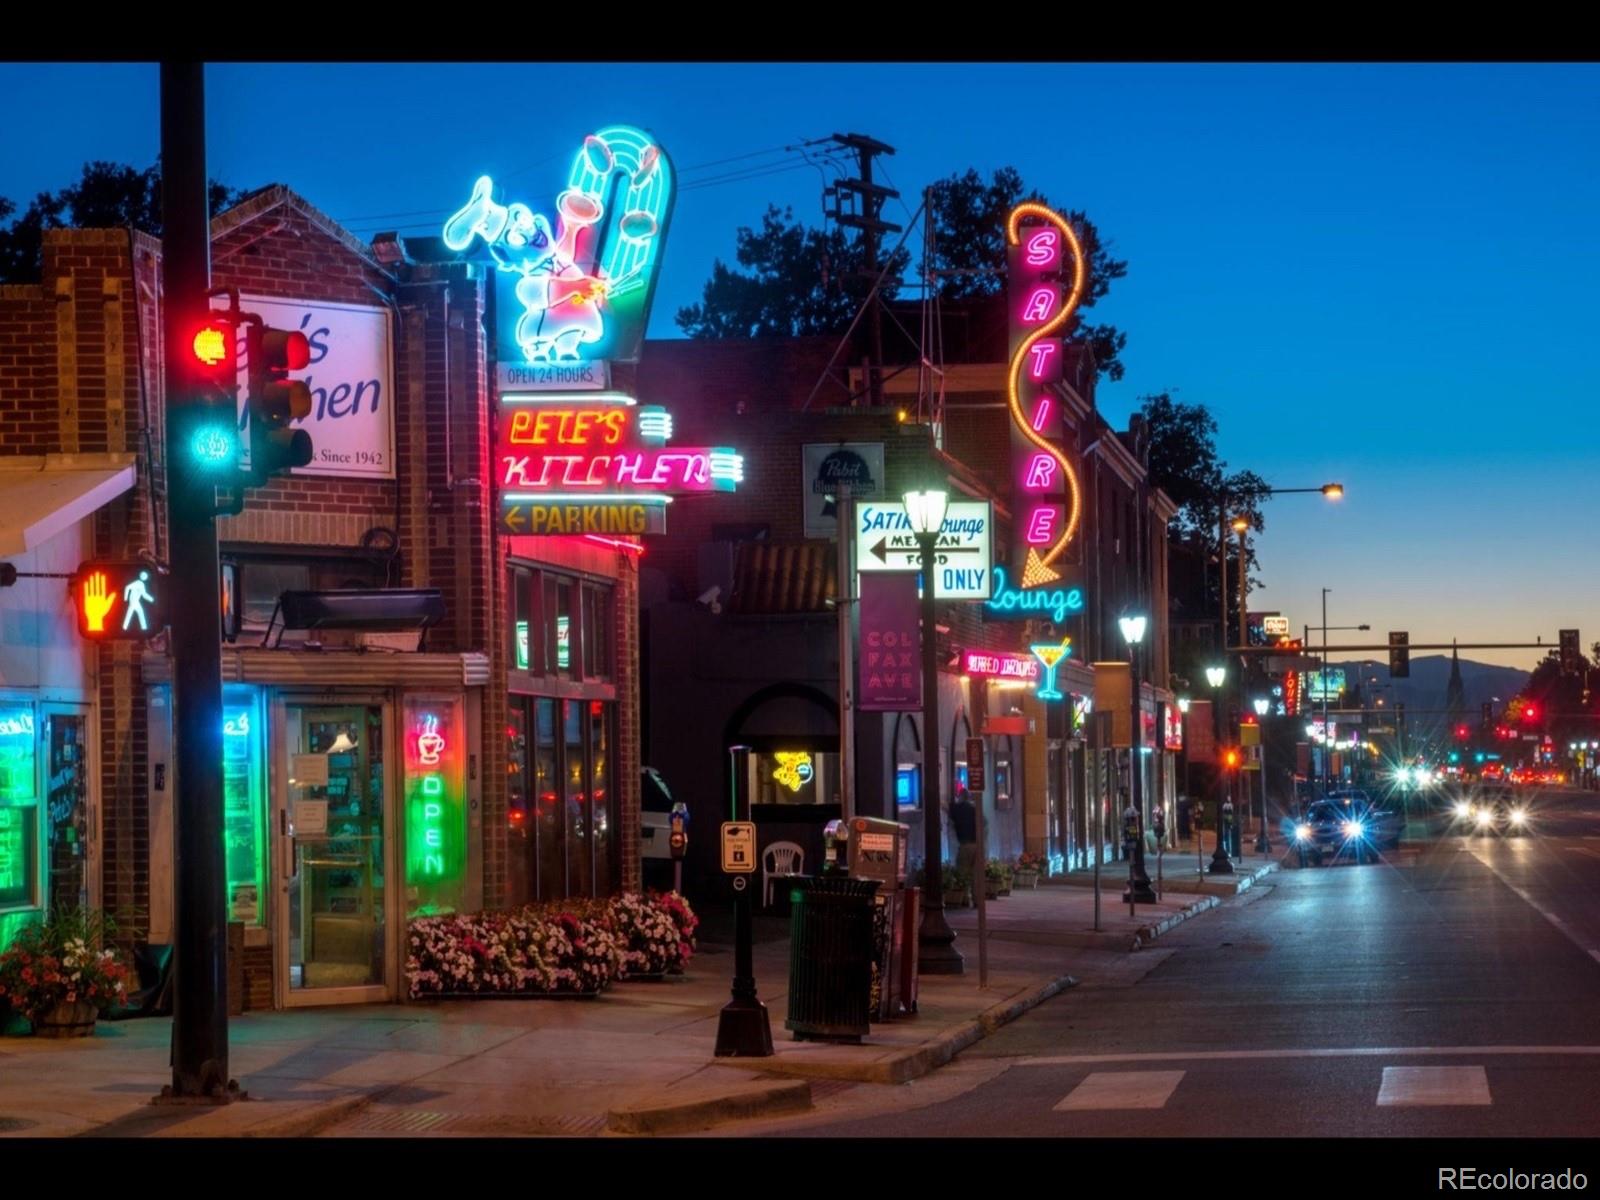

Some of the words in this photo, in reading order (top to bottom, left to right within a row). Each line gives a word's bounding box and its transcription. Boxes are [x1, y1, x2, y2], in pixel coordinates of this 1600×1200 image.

[507, 370, 535, 384] OPEN
[539, 370, 553, 384] 24
[557, 367, 594, 382] HOURS
[1023, 230, 1057, 545] SATIRE
[509, 409, 626, 444] PETE'S
[321, 449, 351, 464] Since
[355, 451, 383, 465] 1942
[502, 454, 709, 486] KITCHEN
[531, 505, 647, 532] PARKING
[861, 508, 913, 533] SATIR
[939, 519, 984, 540] ounge
[891, 536, 960, 546] MEXAN
[906, 555, 948, 565] FOD
[943, 569, 985, 590] ONLY
[985, 568, 1083, 623] Lounge
[867, 631, 912, 648] COL
[868, 652, 912, 667] FAX
[867, 673, 913, 688] AVE
[424, 776, 444, 876] OPEN
